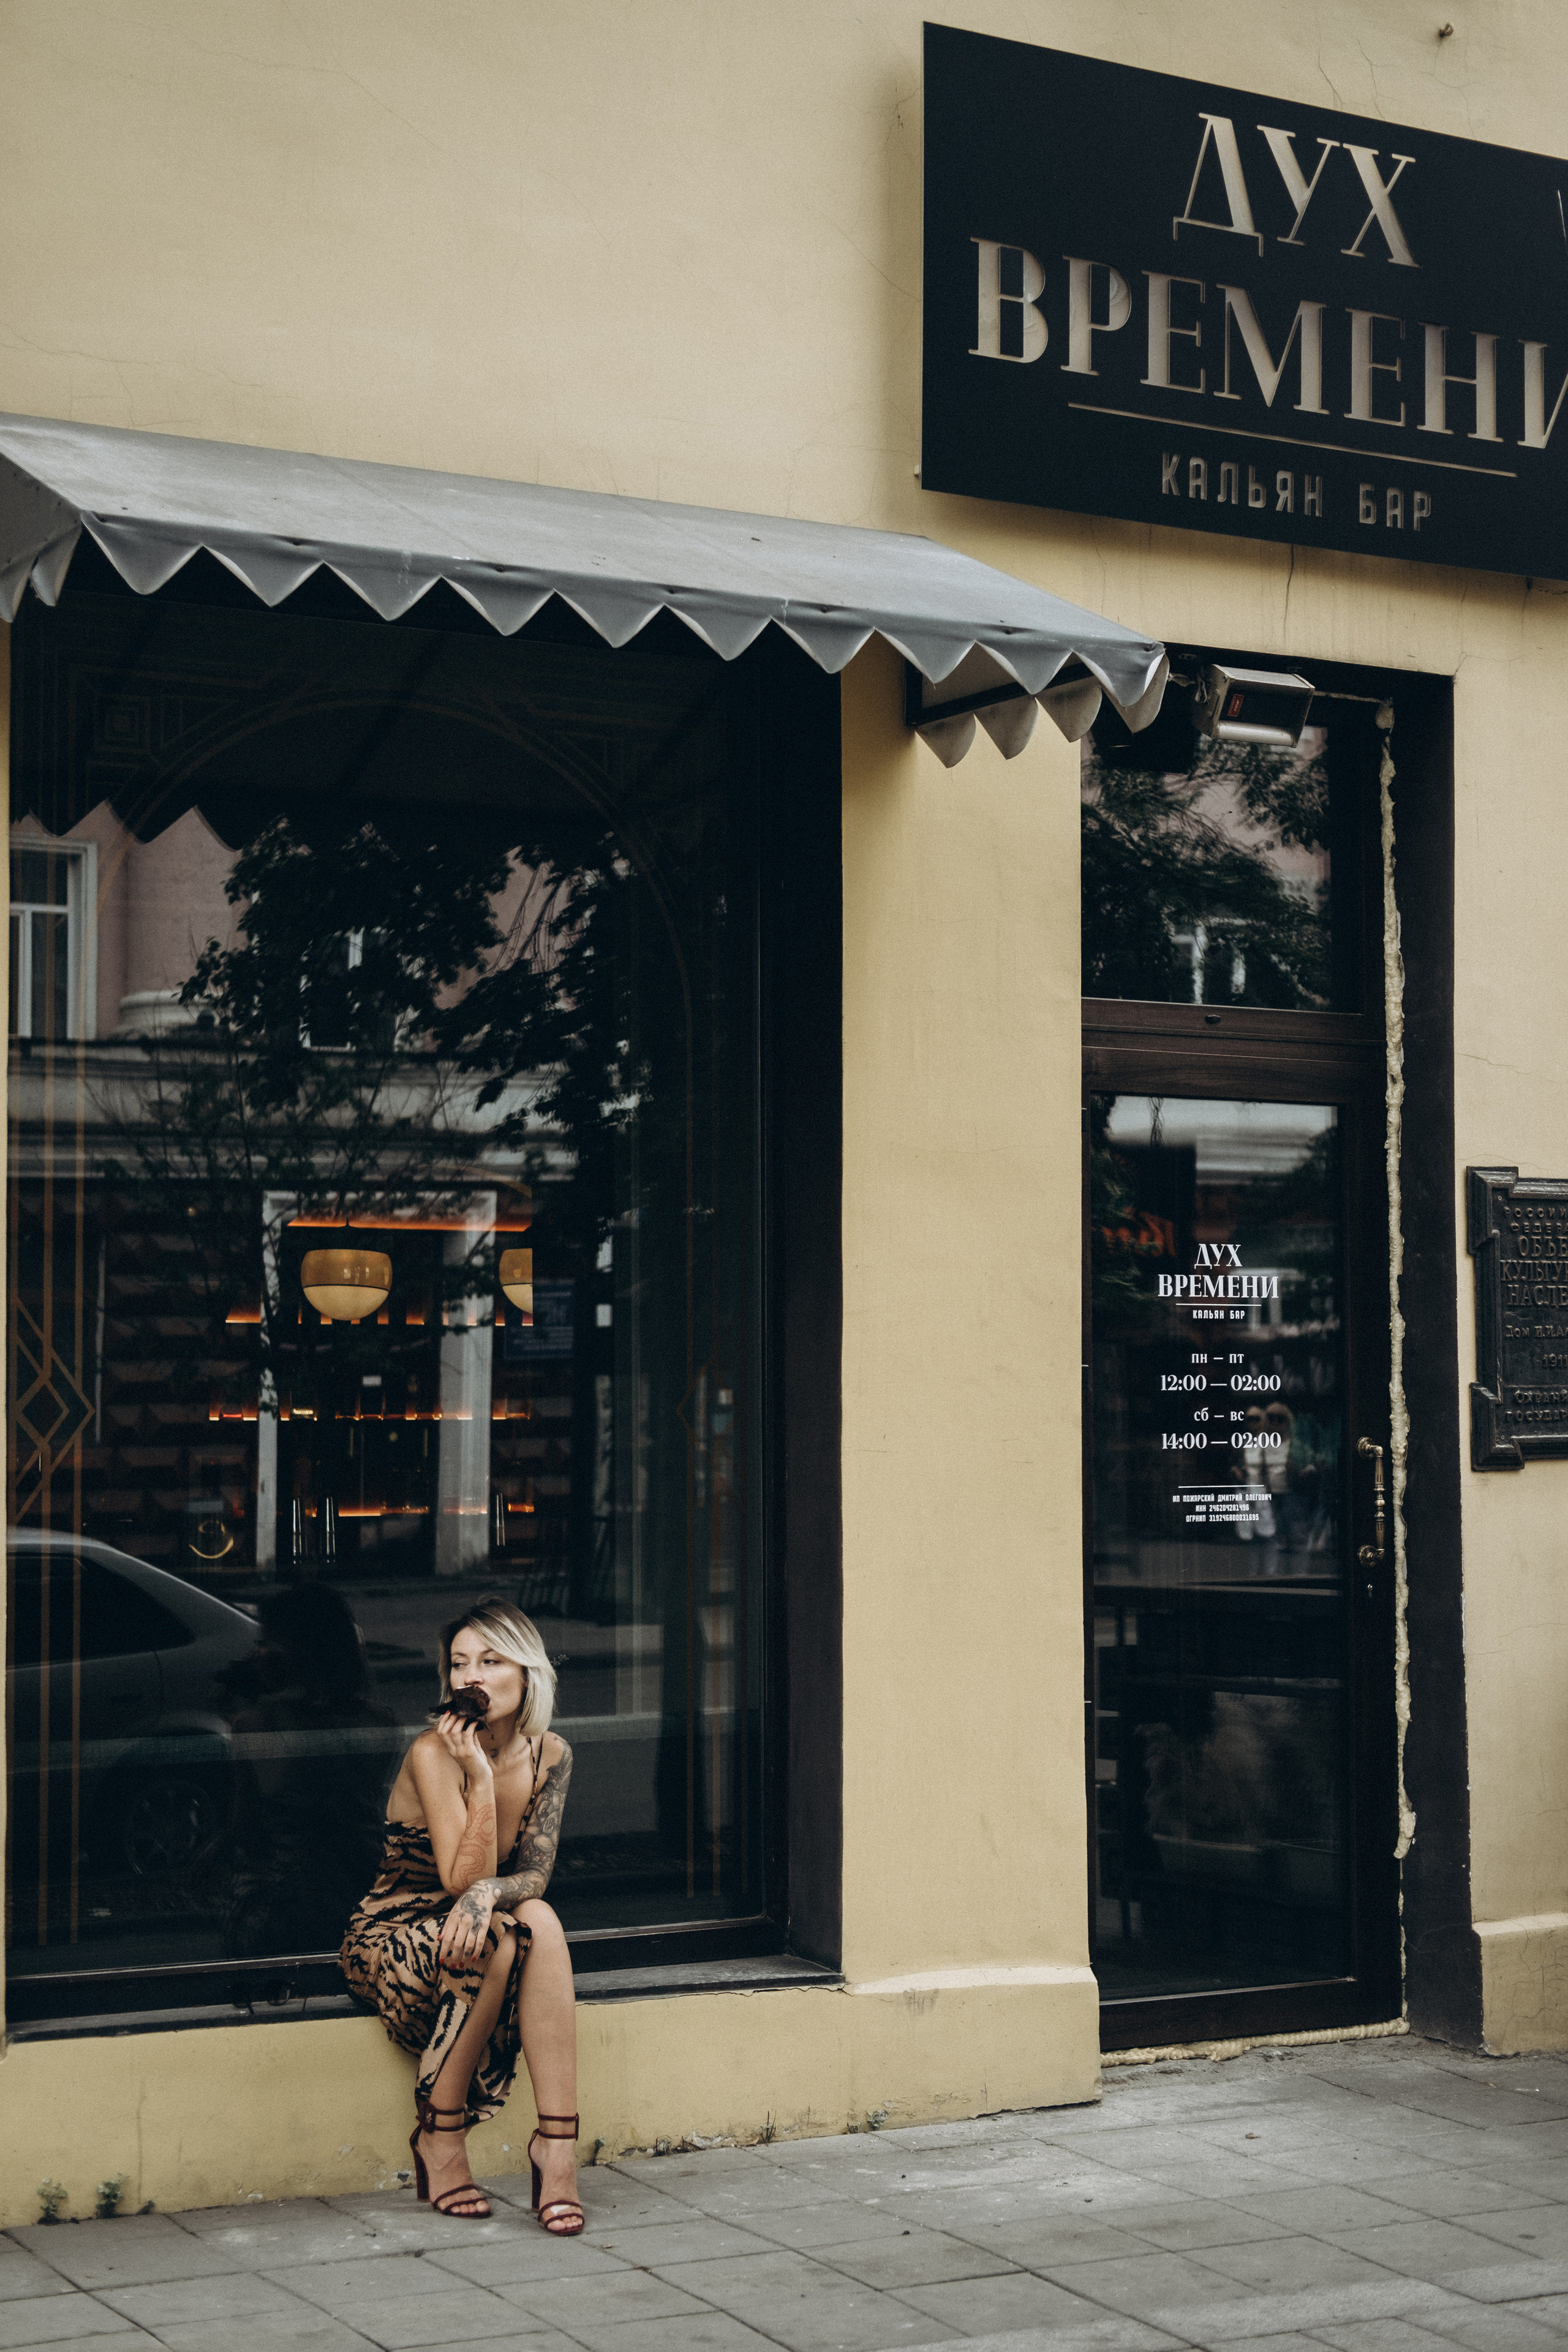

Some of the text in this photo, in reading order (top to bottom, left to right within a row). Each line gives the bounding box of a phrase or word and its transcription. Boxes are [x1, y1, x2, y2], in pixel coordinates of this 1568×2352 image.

[1172, 112, 1421, 268] ДУХ
[1162, 451, 1432, 532] КАЛЬЯН БАР
[1194, 1243, 1243, 1270] ДУХ
[1158, 1274, 1279, 1298] ВРЕМЕНИ
[1193, 1310, 1245, 1319] КАЛЬЯН БАР
[1161, 1374, 1207, 1391] 12:00
[1231, 1374, 1281, 1391] 02:00
[1194, 1407, 1209, 1422] сб
[1231, 1411, 1245, 1421] вс
[1162, 1433, 1207, 1449] 14:00
[1231, 1432, 1281, 1449] 02:00
[1183, 1493, 1215, 1502] ПОЖАРСКИЙ
[1217, 1493, 1243, 1502] ДМИТРИЙ
